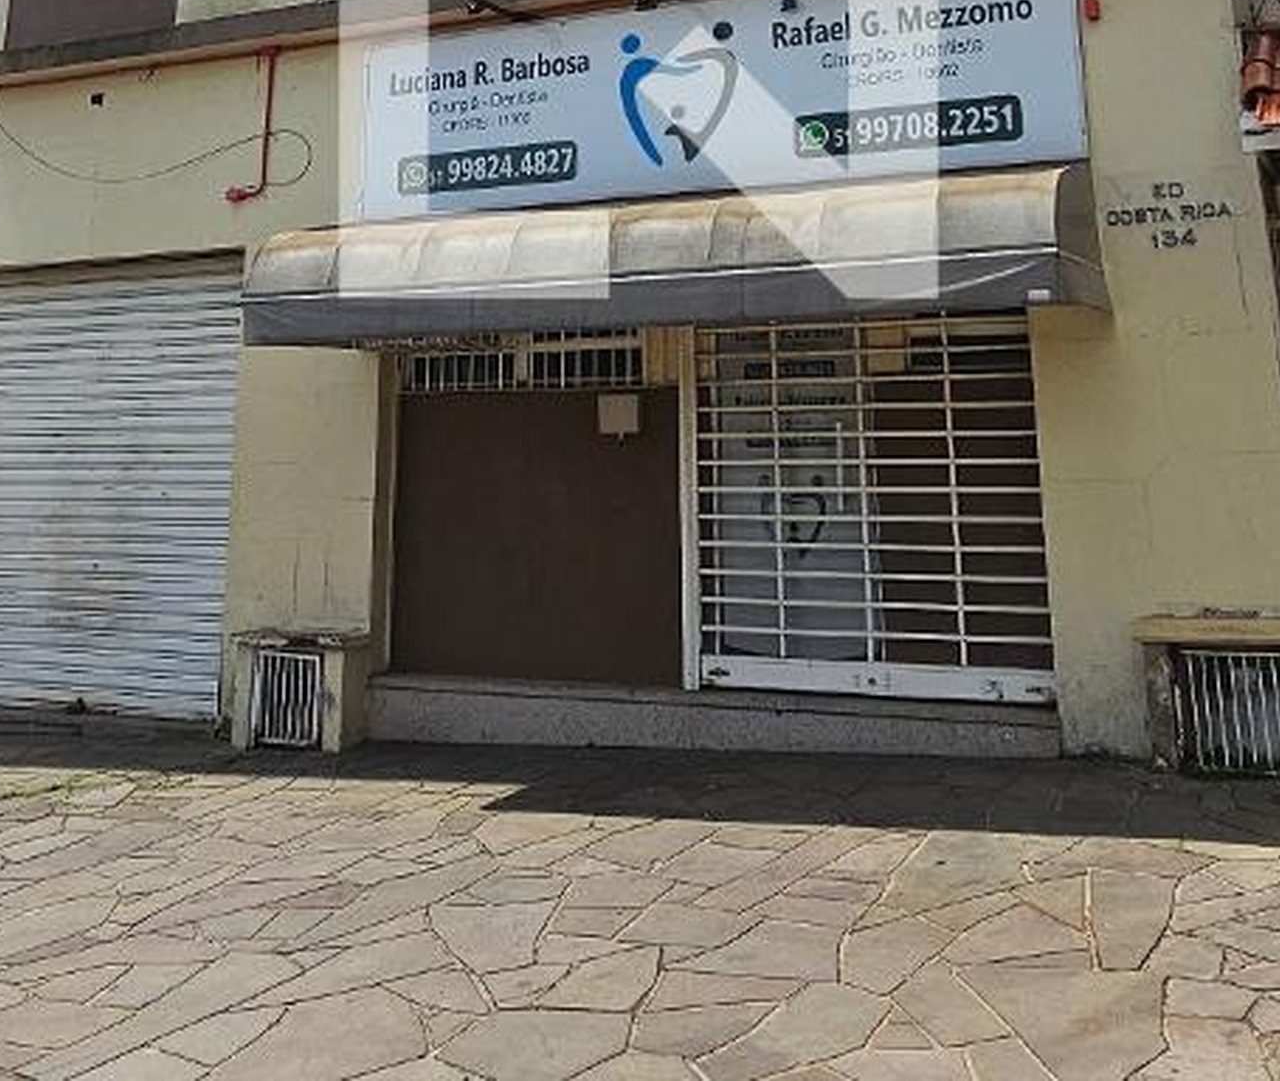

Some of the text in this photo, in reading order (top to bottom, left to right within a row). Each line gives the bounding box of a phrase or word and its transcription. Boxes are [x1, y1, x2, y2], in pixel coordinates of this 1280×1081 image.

[772, 0, 1033, 49] Rafael G. Mezzomo
[389, 53, 590, 96] Luciana R. Barbosa
[856, 104, 1014, 145] 99708.2251
[447, 148, 574, 184] 99824.4827
[1106, 202, 1233, 226] COSTA RICA
[1152, 228, 1198, 249] 134
